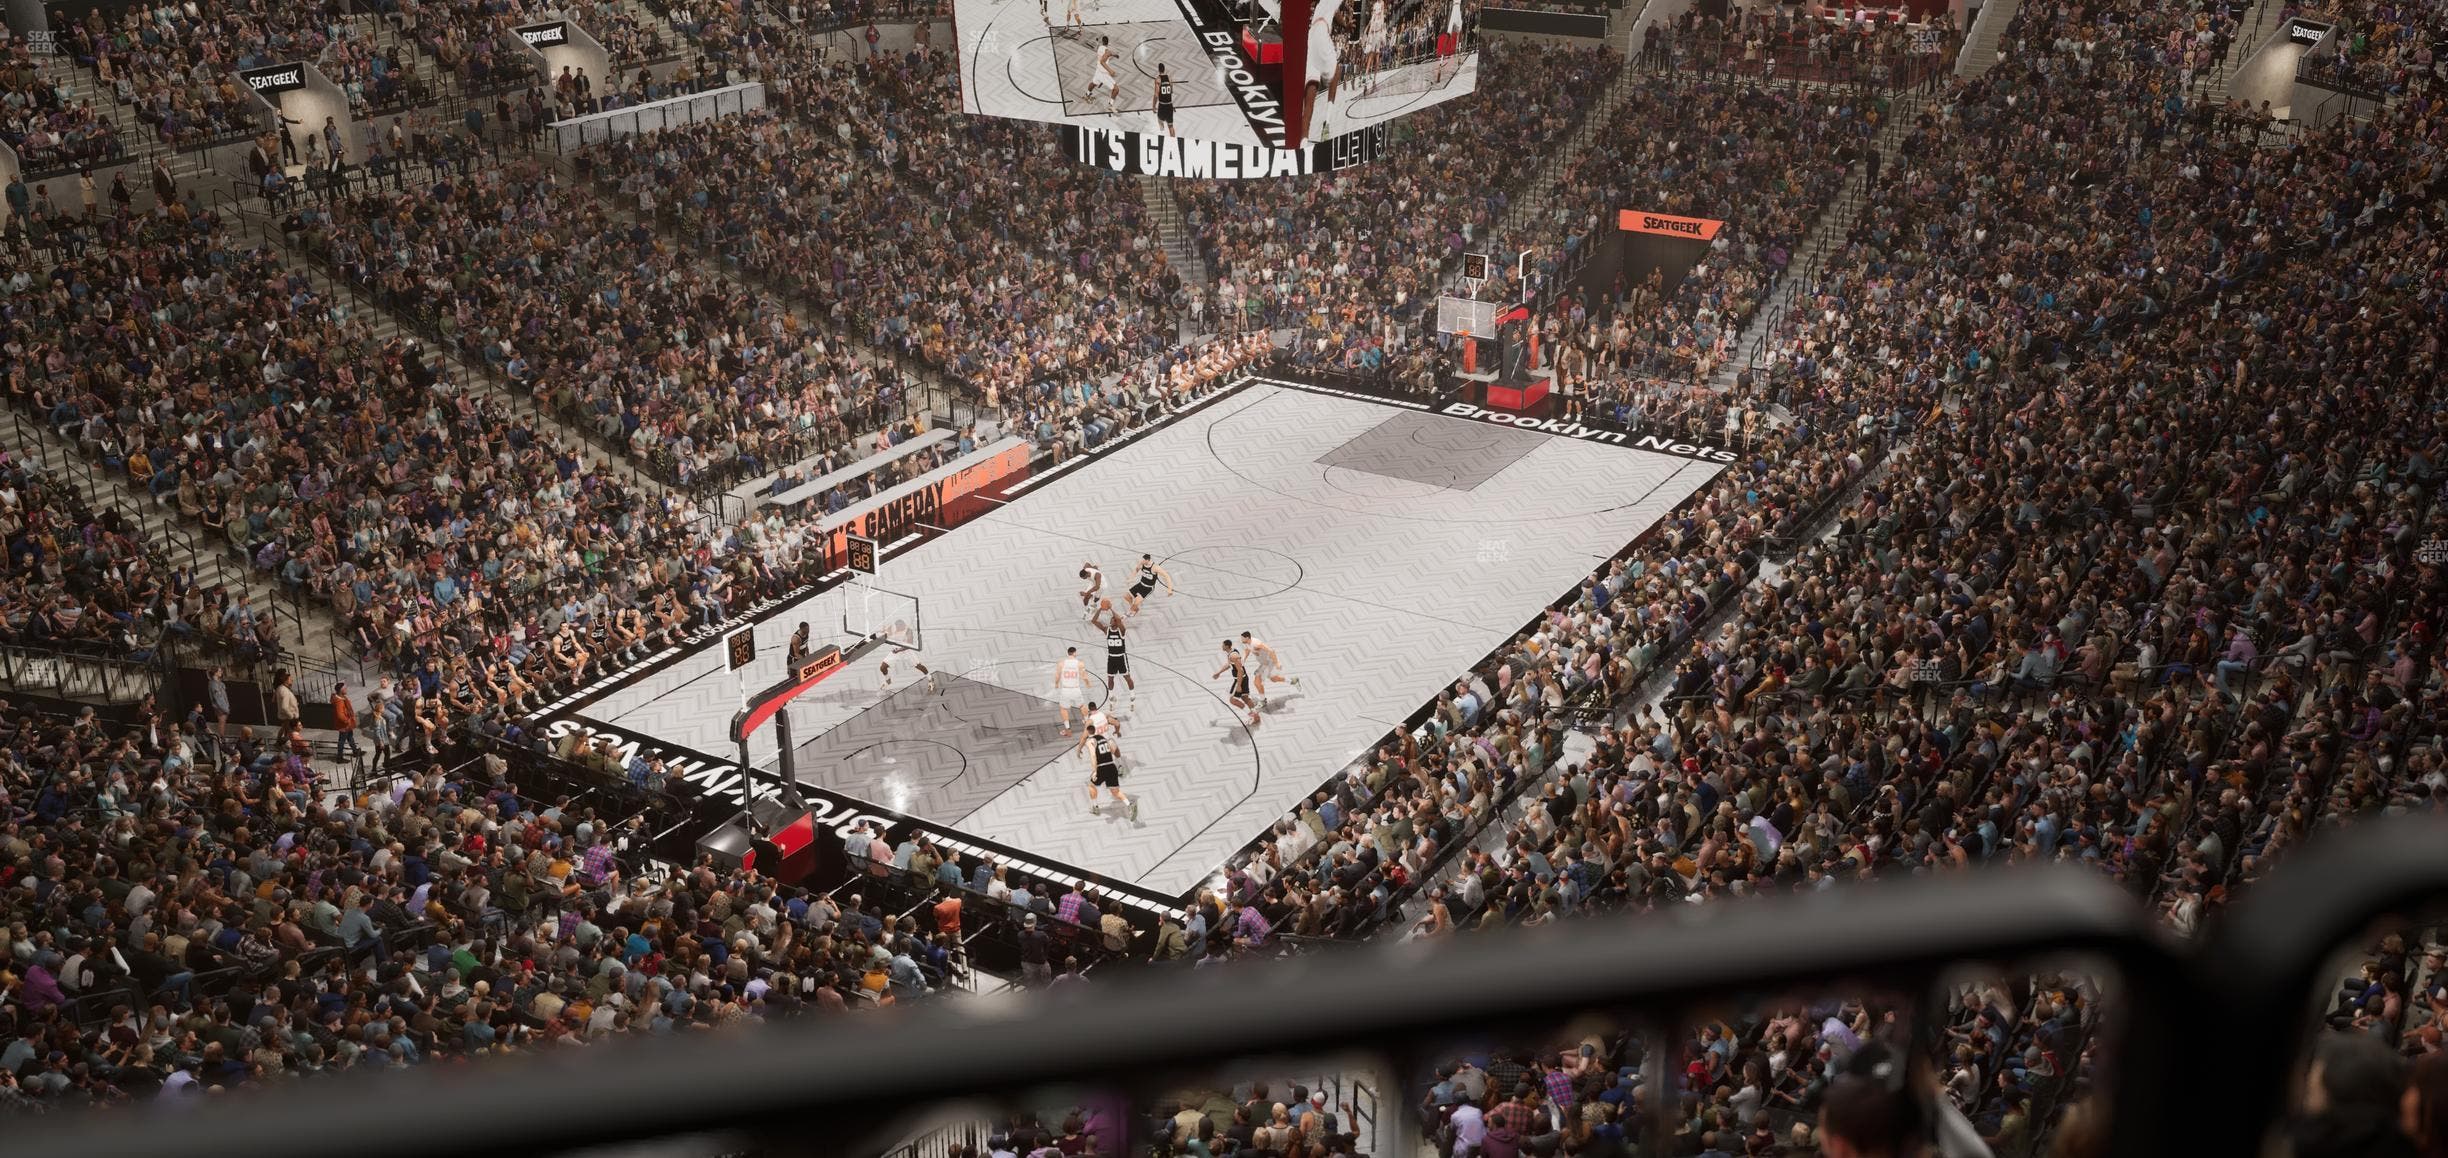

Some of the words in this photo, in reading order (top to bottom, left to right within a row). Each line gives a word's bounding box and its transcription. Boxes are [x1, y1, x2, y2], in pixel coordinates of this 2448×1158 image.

[249, 69, 299, 90] SEATGEEK
[1079, 125, 1126, 171] IT'S
[1139, 133, 1315, 179] GAMEDAY
[1643, 216, 1703, 235] SEATGEEK
[1442, 402, 1627, 444] Brooklyn
[1635, 435, 1739, 462] Nets
[803, 653, 836, 678] SEATGEEK
